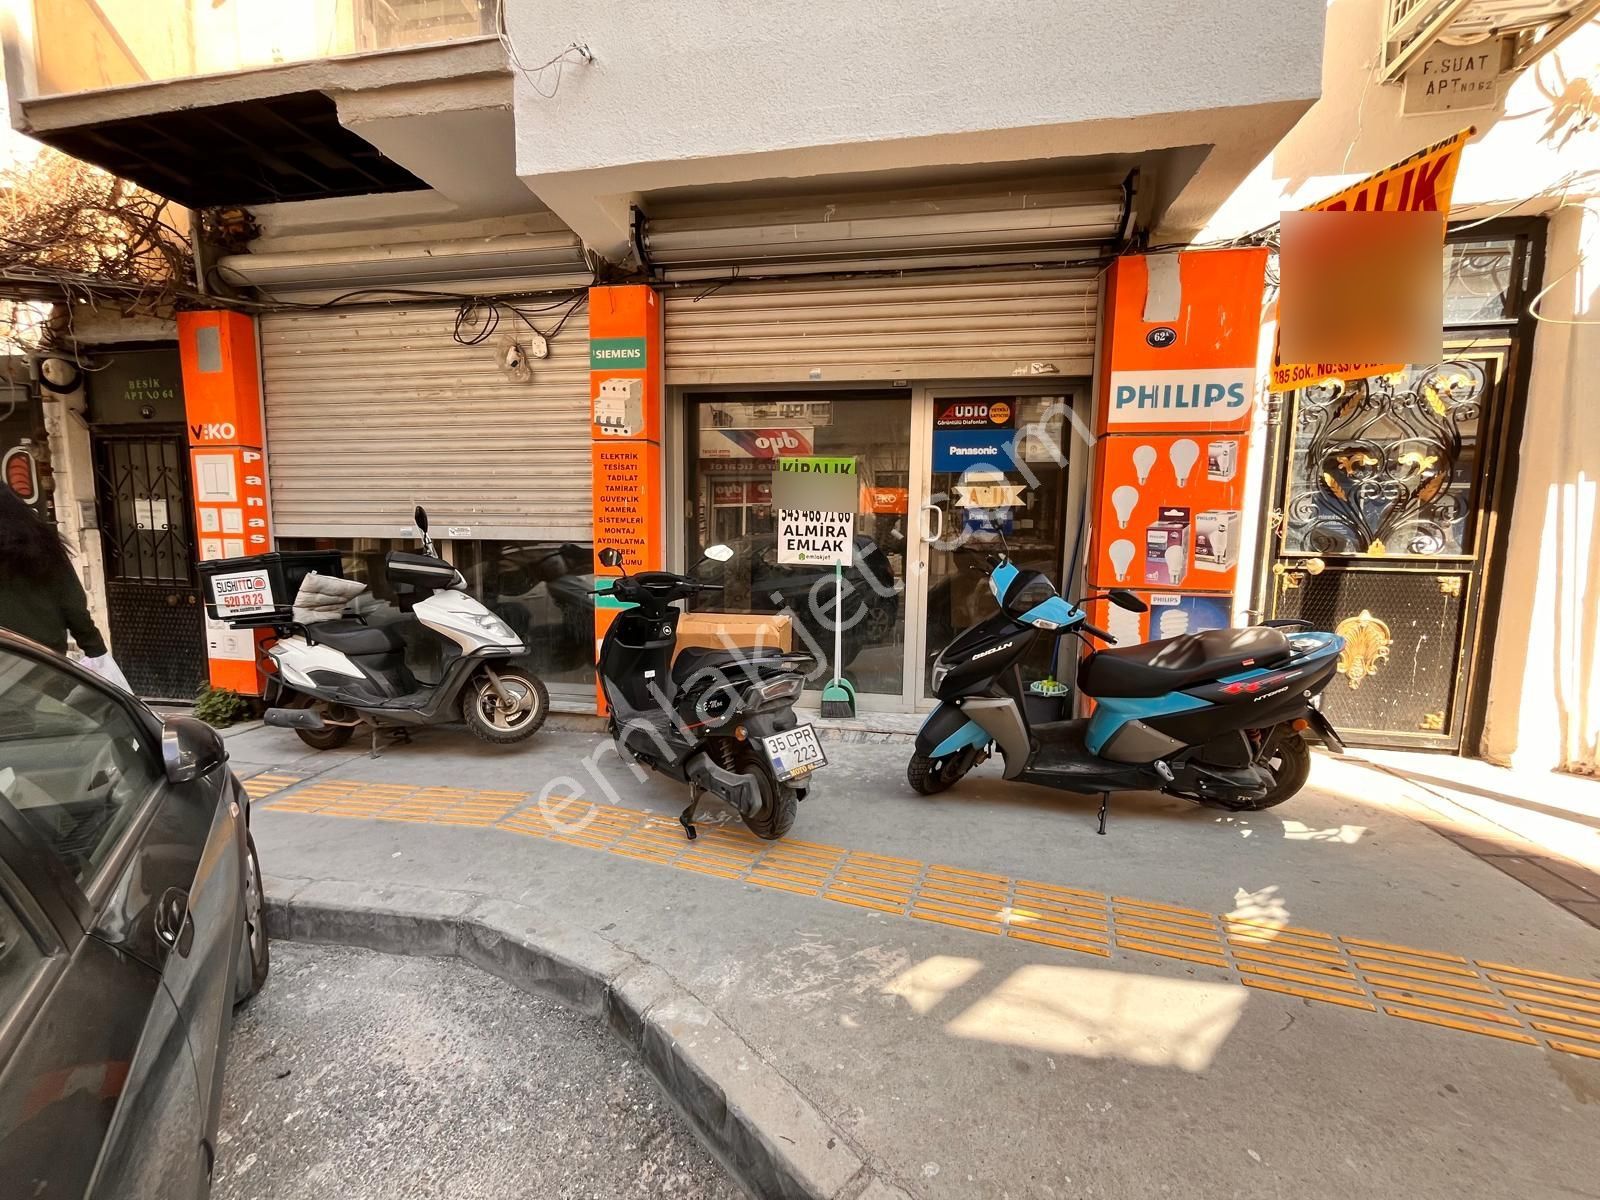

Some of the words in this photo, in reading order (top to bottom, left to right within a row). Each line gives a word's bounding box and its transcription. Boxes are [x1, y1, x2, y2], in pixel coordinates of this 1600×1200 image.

[1426, 77, 1462, 96] APT
[596, 348, 641, 359] SIEMENS
[1293, 365, 1314, 382] Sok.
[1115, 382, 1245, 409] PHILIPS
[940, 403, 988, 418] AUDIO
[949, 446, 998, 456] Panasonic
[598, 515, 644, 524] SİSTEMLERİ
[783, 522, 848, 537] ALMİRA
[787, 539, 844, 552] EMLAK
[805, 553, 831, 561] emlakjet
[216, 579, 253, 593] SUSHITTO
[224, 595, 241, 608] 520
[241, 594, 251, 606] 13
[252, 593, 264, 606] 23
[768, 738, 787, 754] 35
[786, 728, 814, 748] CPR
[793, 744, 818, 764] 223
